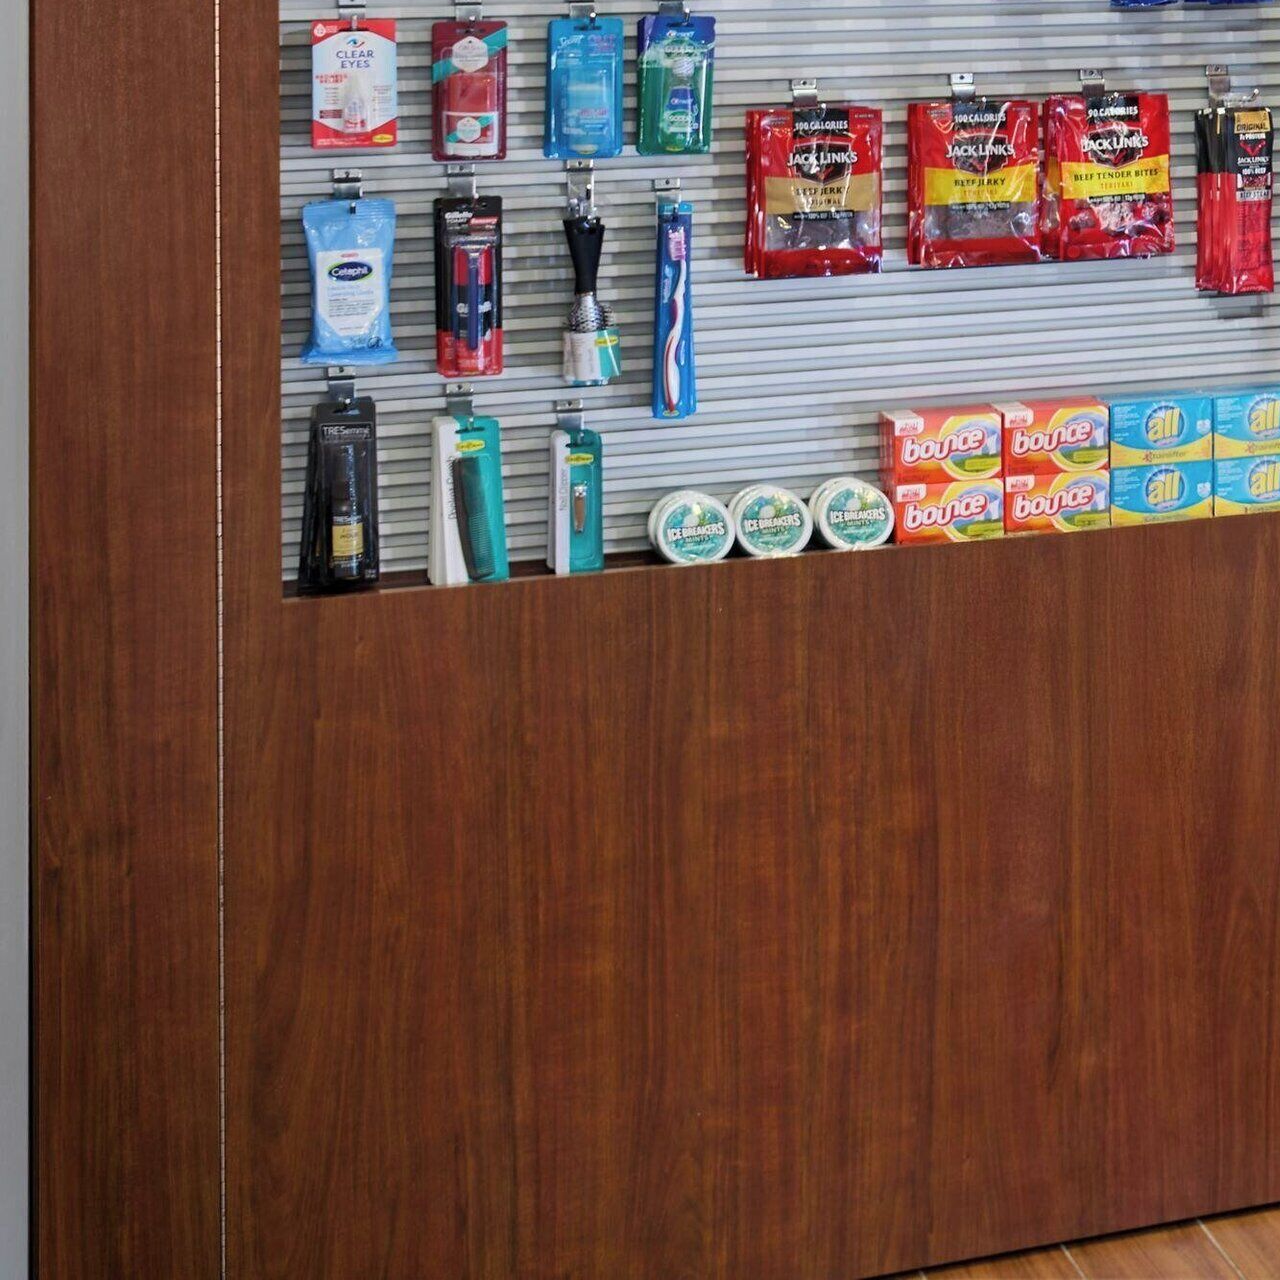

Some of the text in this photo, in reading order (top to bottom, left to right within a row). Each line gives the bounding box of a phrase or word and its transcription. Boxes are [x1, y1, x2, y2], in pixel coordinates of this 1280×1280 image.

[336, 50, 375, 59] CLEAR
[341, 59, 371, 69] EYES
[1088, 108, 1099, 118] 90
[946, 144, 1015, 158] JACK LINK'S
[1081, 135, 1148, 152] JACK LINK'S
[788, 151, 858, 168] JACK LINK'S
[979, 177, 1006, 187] JERKY
[1073, 168, 1159, 182] BEEF TENDER BITES
[1148, 407, 1181, 444] all
[1012, 419, 1094, 455] bounce
[902, 427, 986, 466] bounce
[1148, 470, 1181, 506] all
[1013, 483, 1096, 521] bounce
[905, 493, 989, 530] bounce
